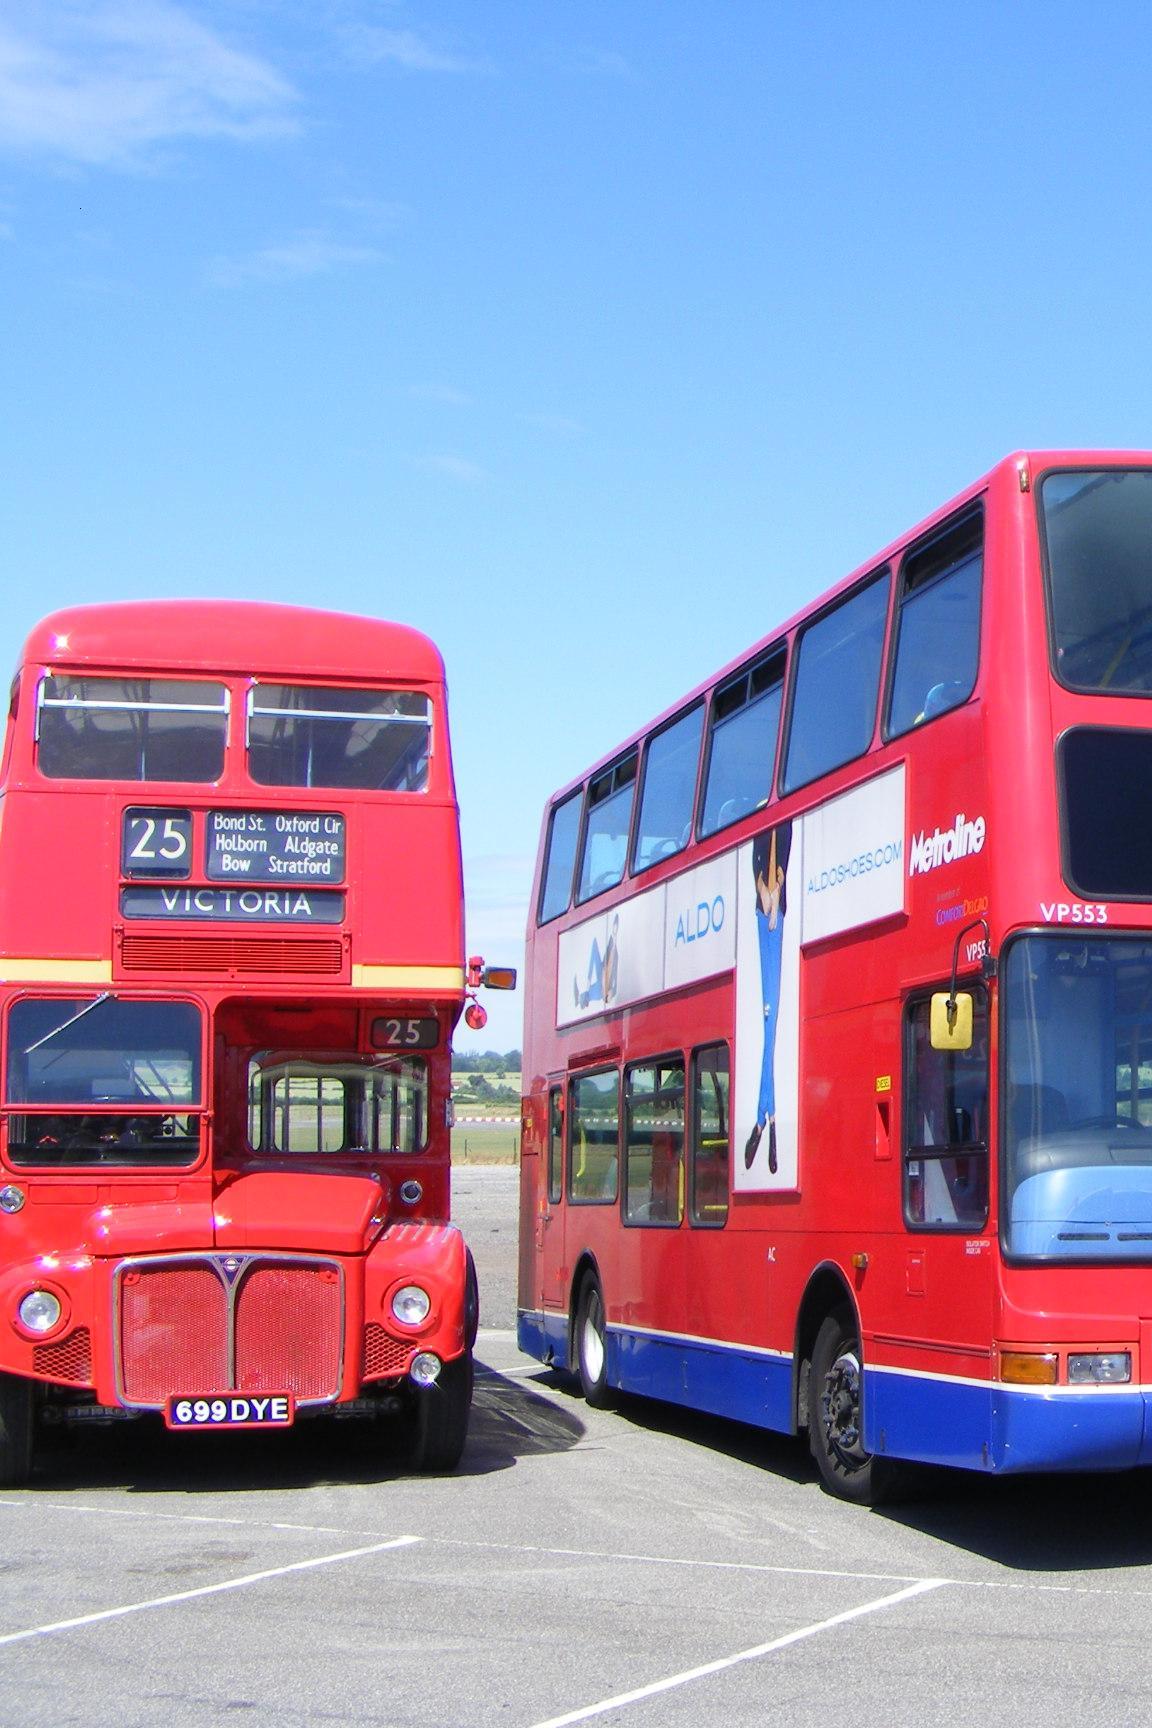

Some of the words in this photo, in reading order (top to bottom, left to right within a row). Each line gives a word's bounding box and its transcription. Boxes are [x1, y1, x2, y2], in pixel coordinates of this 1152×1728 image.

[214, 814, 246, 831] Bond
[248, 815, 266, 832] St.
[275, 816, 319, 833] Oxford
[324, 818, 341, 833] Cir
[130, 818, 187, 859] 25
[215, 834, 267, 852] Holborn
[284, 836, 339, 858] Aldgate
[909, 813, 986, 877] Metroline
[222, 854, 251, 872] Bow
[268, 856, 331, 875] Stratford
[807, 839, 903, 896] ALDOSHOES.COM
[161, 889, 312, 915] VICTORIA
[1040, 902, 1108, 923] VP553
[675, 894, 726, 948] ALDO
[386, 1019, 421, 1044] 25
